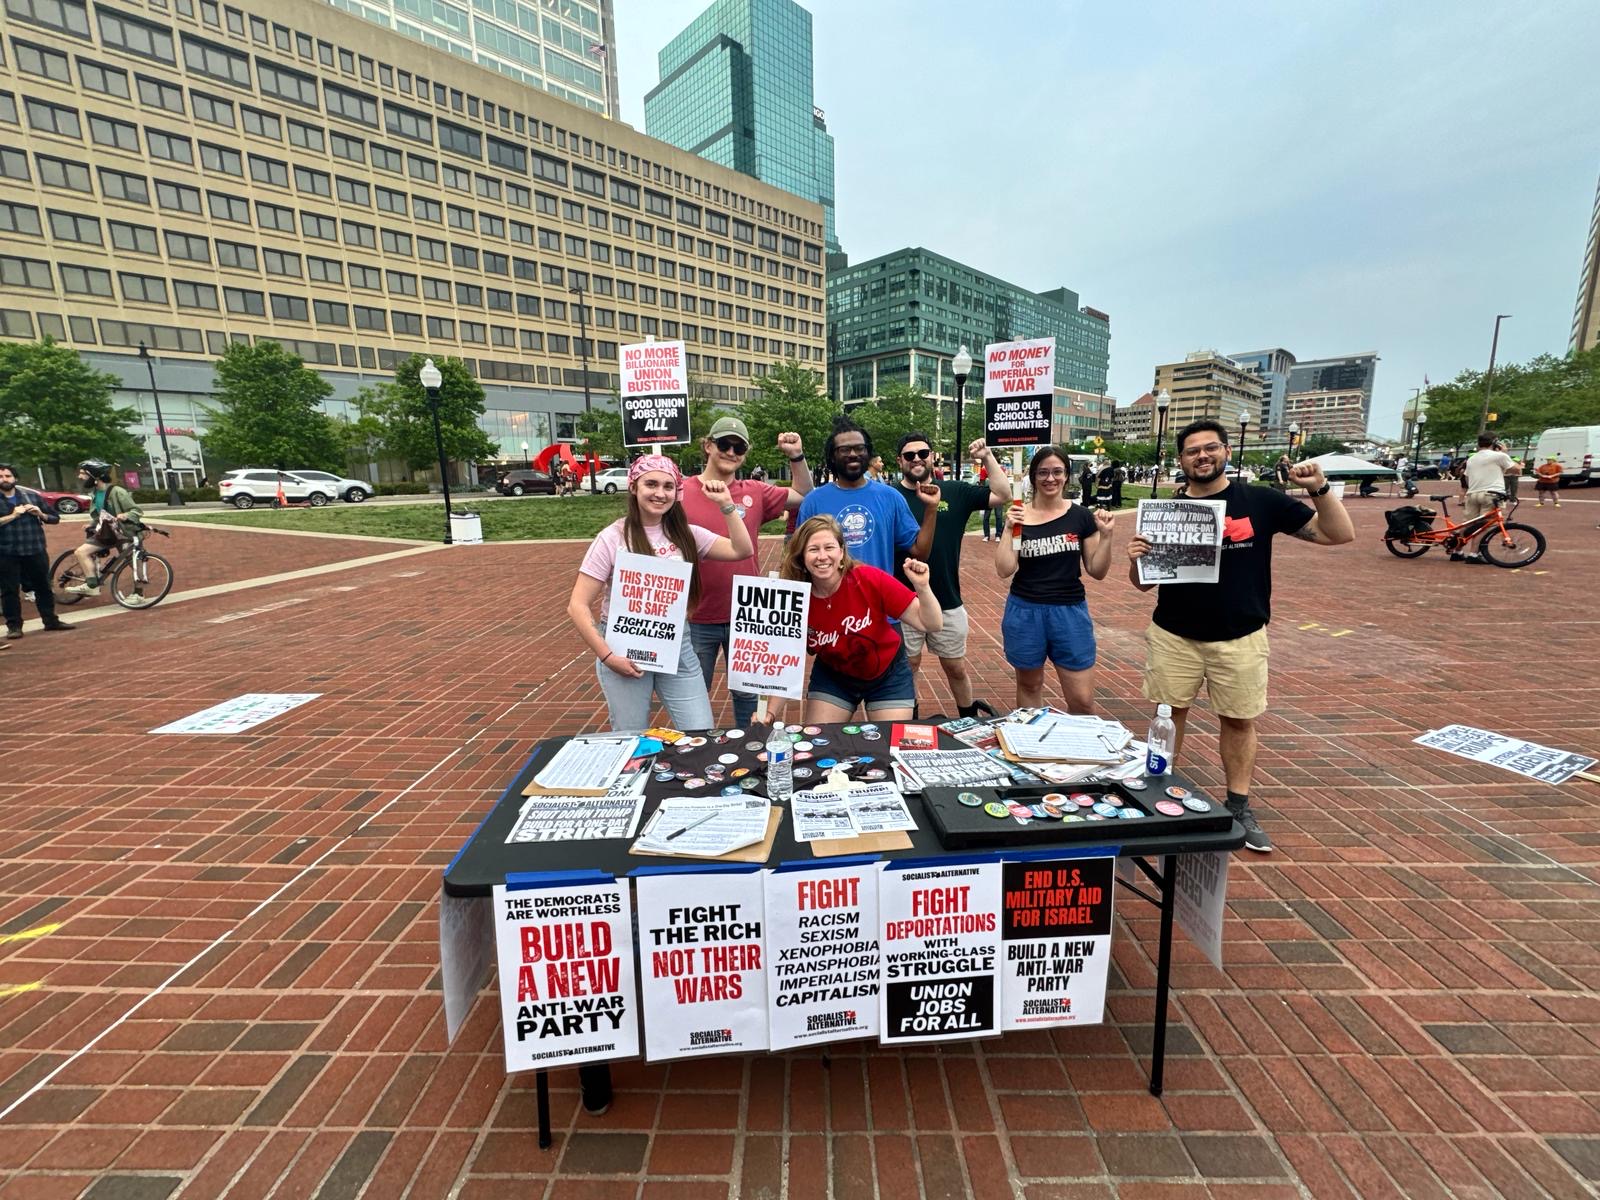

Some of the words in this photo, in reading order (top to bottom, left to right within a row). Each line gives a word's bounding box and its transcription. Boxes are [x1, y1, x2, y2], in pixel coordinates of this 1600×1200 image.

[625, 349, 641, 361] NO
[645, 347, 679, 359] MORE
[989, 351, 1006, 363] NO
[1009, 346, 1051, 361] MONEY
[625, 359, 680, 369] BILLIONAIRE
[1011, 360, 1025, 369] FOR
[634, 368, 672, 380] UNION
[990, 366, 1050, 380] IMPERIALIST
[628, 379, 680, 393] BUSTING
[1003, 378, 1036, 393] WAR
[625, 399, 653, 410] GOOD
[654, 398, 685, 408] UNION
[997, 402, 1020, 412] FUND
[1021, 401, 1041, 410] OUR
[632, 409, 657, 420] JOBS
[658, 408, 678, 418] FOR
[994, 411, 1035, 421] SCHOOLS
[1036, 410, 1043, 419] &
[644, 418, 668, 432] ALL
[988, 419, 1049, 431] COMMUNITIES
[1143, 511, 1165, 521] SHUT
[1166, 511, 1188, 521] DOWN
[1188, 511, 1214, 522] TRUMP
[1142, 522, 1162, 531] BUILD
[1163, 522, 1177, 532] FOR
[1178, 523, 1183, 531] A
[1183, 523, 1215, 533] ONE-DAY
[1022, 534, 1067, 549] SOCIALIST
[1142, 531, 1215, 544] STRIKE
[1020, 542, 1080, 557] ALTERNATIVE
[619, 569, 642, 585] THIS
[643, 572, 685, 593] SYSTEM
[622, 584, 653, 601] CAN'T
[654, 589, 679, 605] KEEP
[737, 585, 804, 613] UNITE
[628, 599, 642, 613] US
[644, 601, 669, 618] SAFE
[616, 616, 651, 629] FIGHT
[652, 620, 676, 632] FOR
[735, 607, 764, 624] ALL
[768, 611, 802, 628] OUR
[612, 623, 676, 641] SOCIALISM
[734, 621, 802, 639] STRUGGLES
[808, 630, 839, 647] Stay
[841, 608, 872, 635] Red
[733, 638, 770, 652] MASS
[732, 650, 780, 665] ACTION
[781, 654, 800, 667] ON
[732, 661, 760, 674] MAY
[763, 664, 784, 676] 1ST
[910, 759, 932, 768] SHUT
[933, 758, 957, 766] DOWN
[958, 755, 987, 764] TRUMP
[586, 799, 638, 808] ALTERNATIVE
[528, 809, 557, 819] SHUT
[557, 809, 591, 819] DOWN
[591, 808, 633, 818] TRUMP
[522, 820, 554, 829] BUILD
[555, 820, 573, 828] FOR
[574, 820, 582, 828] A
[583, 818, 629, 827] ONE-DAY
[515, 827, 626, 840] STRIKE
[902, 872, 935, 881] SOCIALIST
[940, 868, 980, 878] ALTERNATIVE
[1024, 871, 1054, 889] END
[1057, 869, 1085, 888] U.S.
[505, 898, 532, 909] THE
[534, 893, 620, 907] DEMOCRATS
[797, 877, 861, 911] FIGHT
[912, 886, 970, 917] FIGHT
[1006, 888, 1072, 909] MILITARY
[1077, 887, 1102, 906] AID
[506, 910, 535, 920] ARE
[536, 904, 621, 918] WORTHLESS
[668, 904, 741, 925] FIGHT
[1012, 909, 1040, 928] FOR
[1044, 906, 1093, 926] ISRAEL
[798, 912, 860, 929] RACISM
[886, 913, 996, 941] DEPORTATIONS
[650, 925, 699, 945] THE
[703, 922, 761, 941] RICH
[799, 928, 859, 944] SEXISM
[520, 921, 612, 963] BUILD
[924, 938, 958, 949] WITH
[778, 940, 880, 962] XENOPHOBIA
[886, 945, 996, 963] WORKING-CLASS
[1007, 943, 1047, 961] BUILD
[1051, 942, 1060, 958] A
[1066, 940, 1095, 957] NEW
[652, 949, 699, 979] NOT
[701, 944, 762, 973] THEIR
[887, 956, 994, 978] STRUGGLE
[1016, 958, 1084, 977] ANTI-WAR
[517, 965, 539, 1003] A
[547, 957, 620, 1000] NEW
[779, 969, 880, 991] IMPERIALISM
[1027, 976, 1070, 993] PARTY
[674, 973, 743, 1005] WARS
[776, 983, 880, 1008] CAPITALISM
[909, 982, 973, 1001] UNION
[517, 995, 624, 1019] ANTI-WAR
[915, 998, 966, 1016] JOBS
[1022, 1005, 1071, 1015] ALTERNATIVE
[1023, 998, 1062, 1008] SOCIALIST
[516, 1009, 626, 1041] PARTY
[807, 1011, 848, 1024] SOCIALIST
[807, 1018, 856, 1031] ALTERNATIVE
[900, 1014, 943, 1033] FOR
[947, 1012, 982, 1030] ALL
[690, 1029, 724, 1039] SOCIALIST
[690, 1035, 732, 1045] ALTERNATIVE
[794, 1025, 868, 1039] www.socialistalternative.org
[531, 1049, 567, 1061] SOCIALIST
[574, 1043, 615, 1056] ALTERNATIVE
